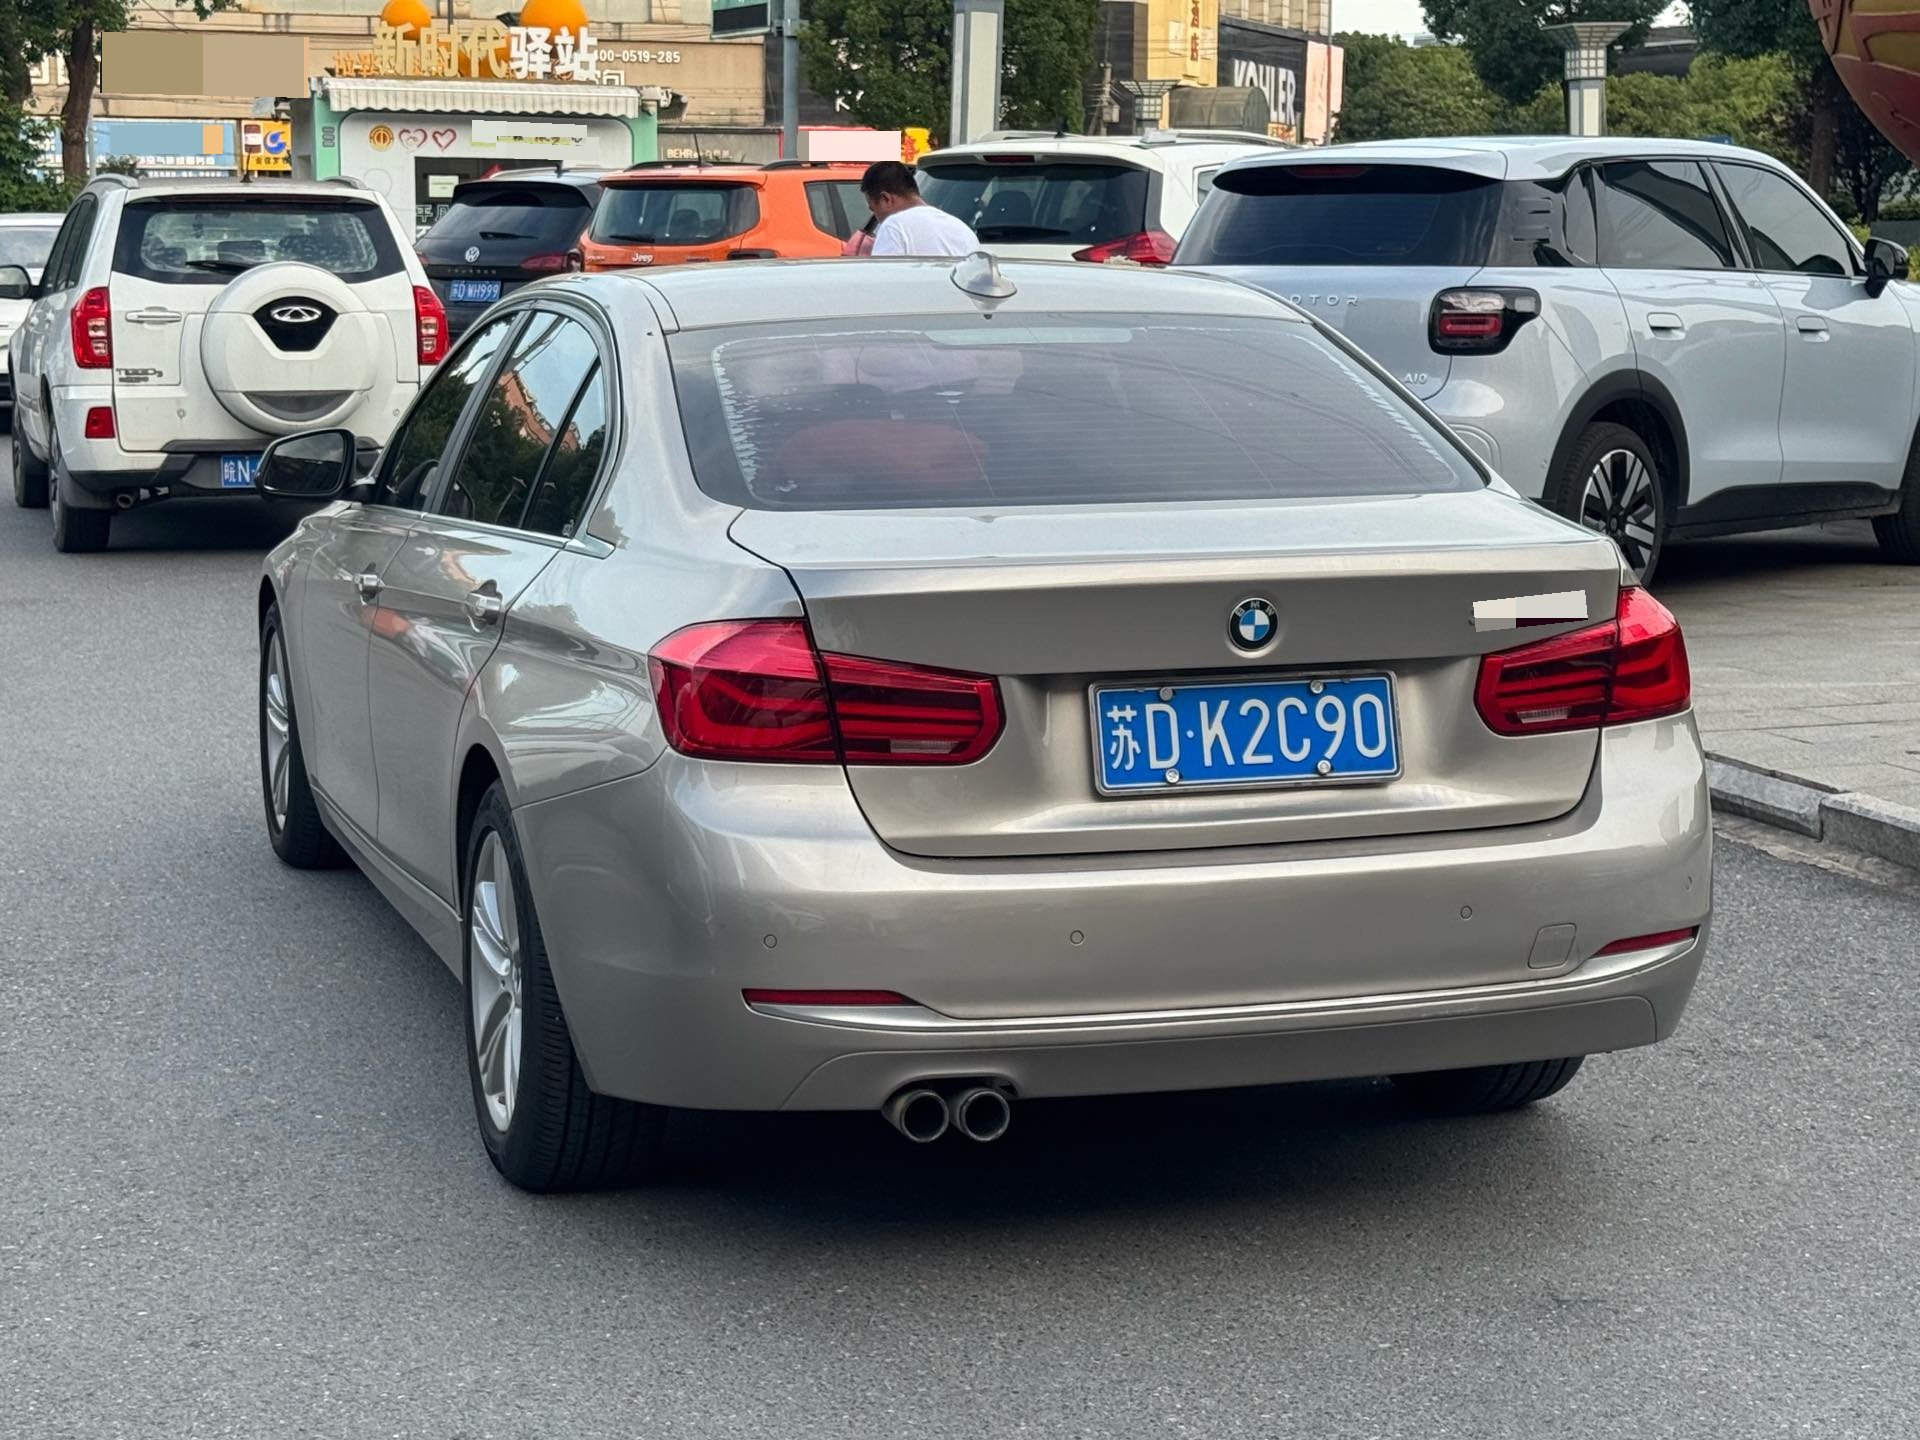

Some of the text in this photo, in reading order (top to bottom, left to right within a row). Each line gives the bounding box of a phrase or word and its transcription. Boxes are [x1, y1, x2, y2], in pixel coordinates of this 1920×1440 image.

[373, 21, 599, 81] 新时代驿站
[595, 49, 681, 63] 00-0519-285
[632, 252, 654, 264] Jeep
